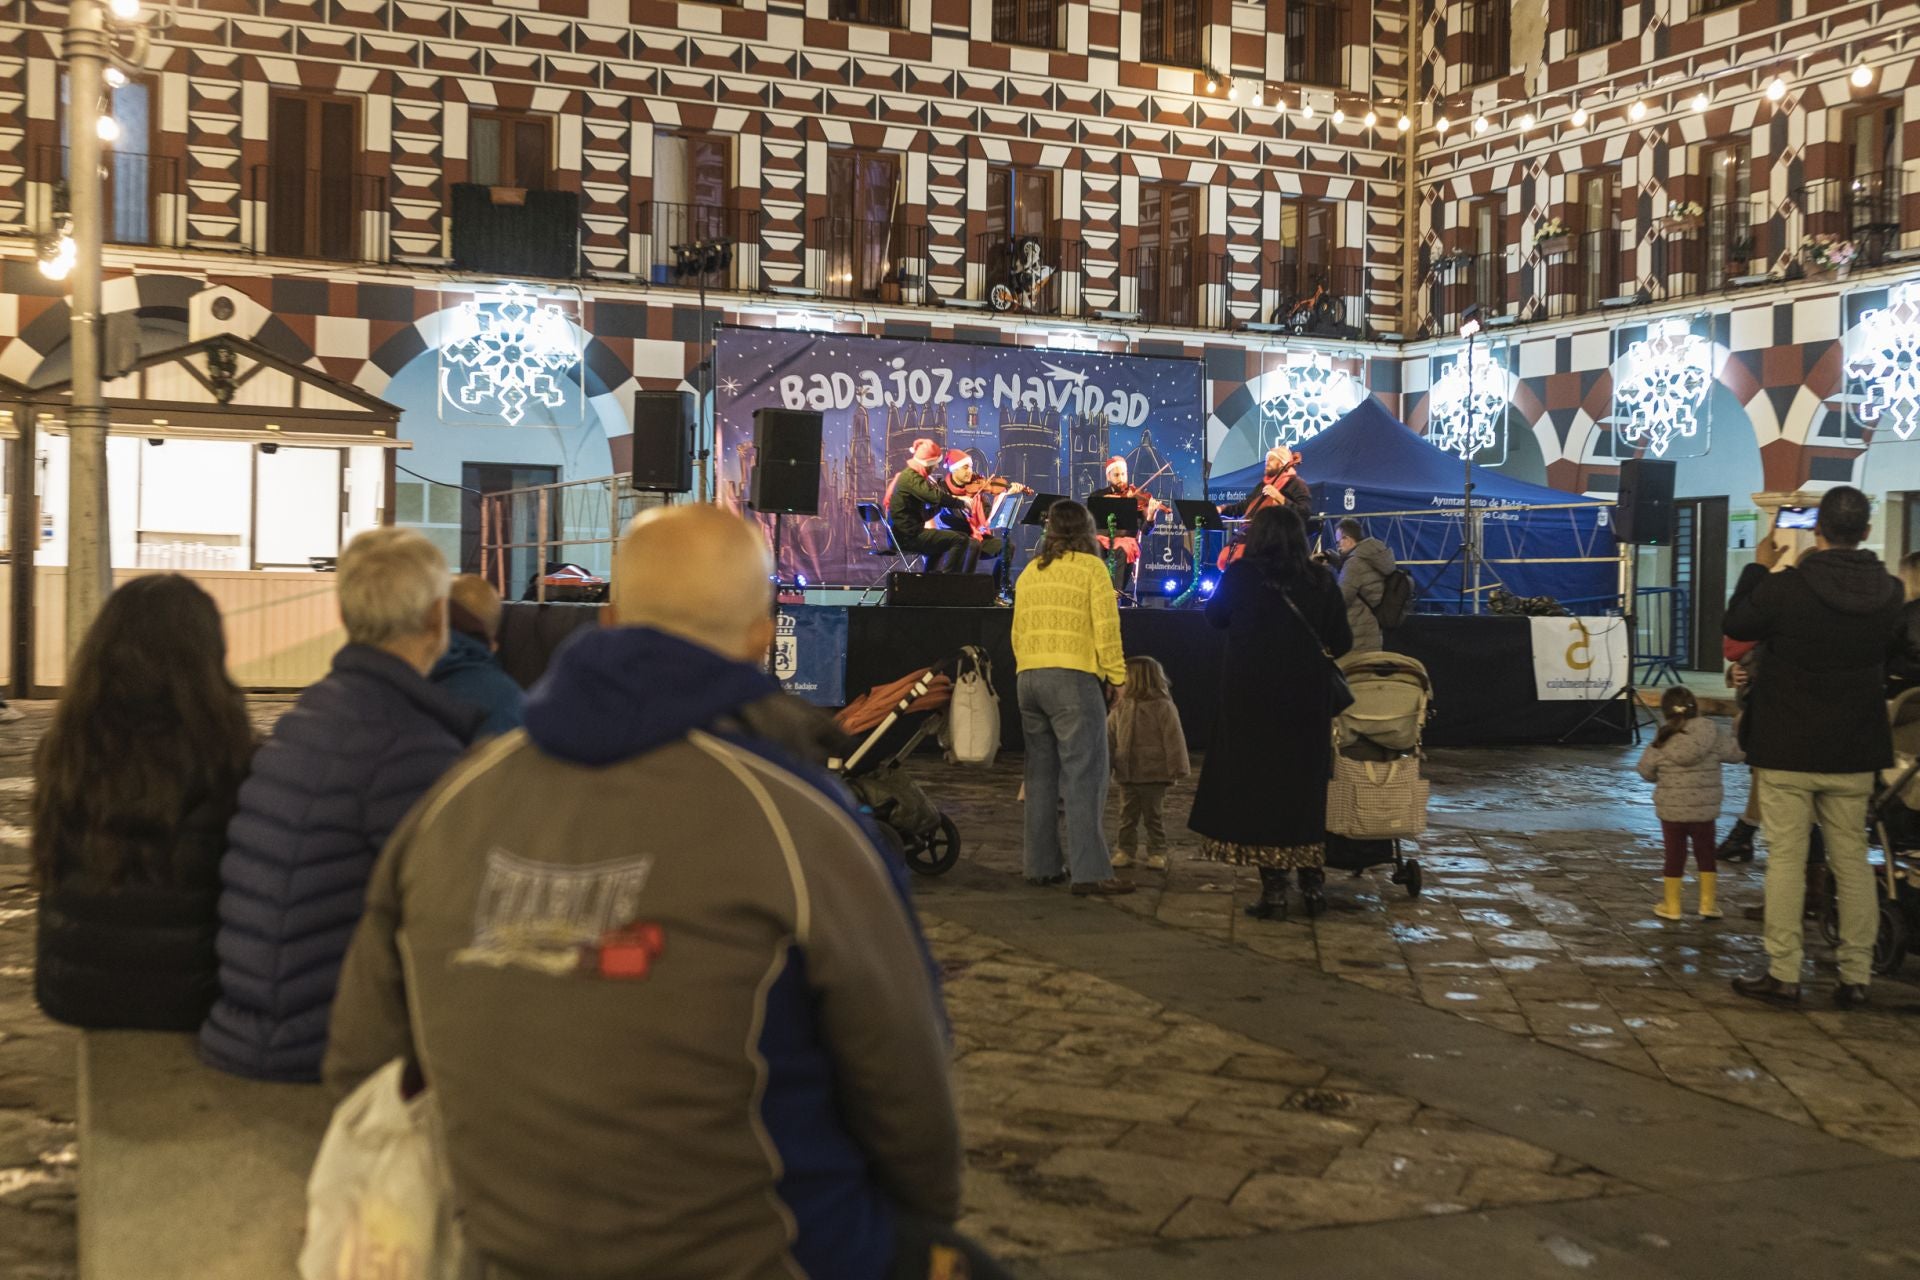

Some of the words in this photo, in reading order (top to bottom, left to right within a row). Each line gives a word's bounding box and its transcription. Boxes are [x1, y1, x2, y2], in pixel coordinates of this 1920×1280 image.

[959, 377, 987, 399] es
[1488, 498, 1499, 508] de
[794, 681, 818, 691] Badajoz
